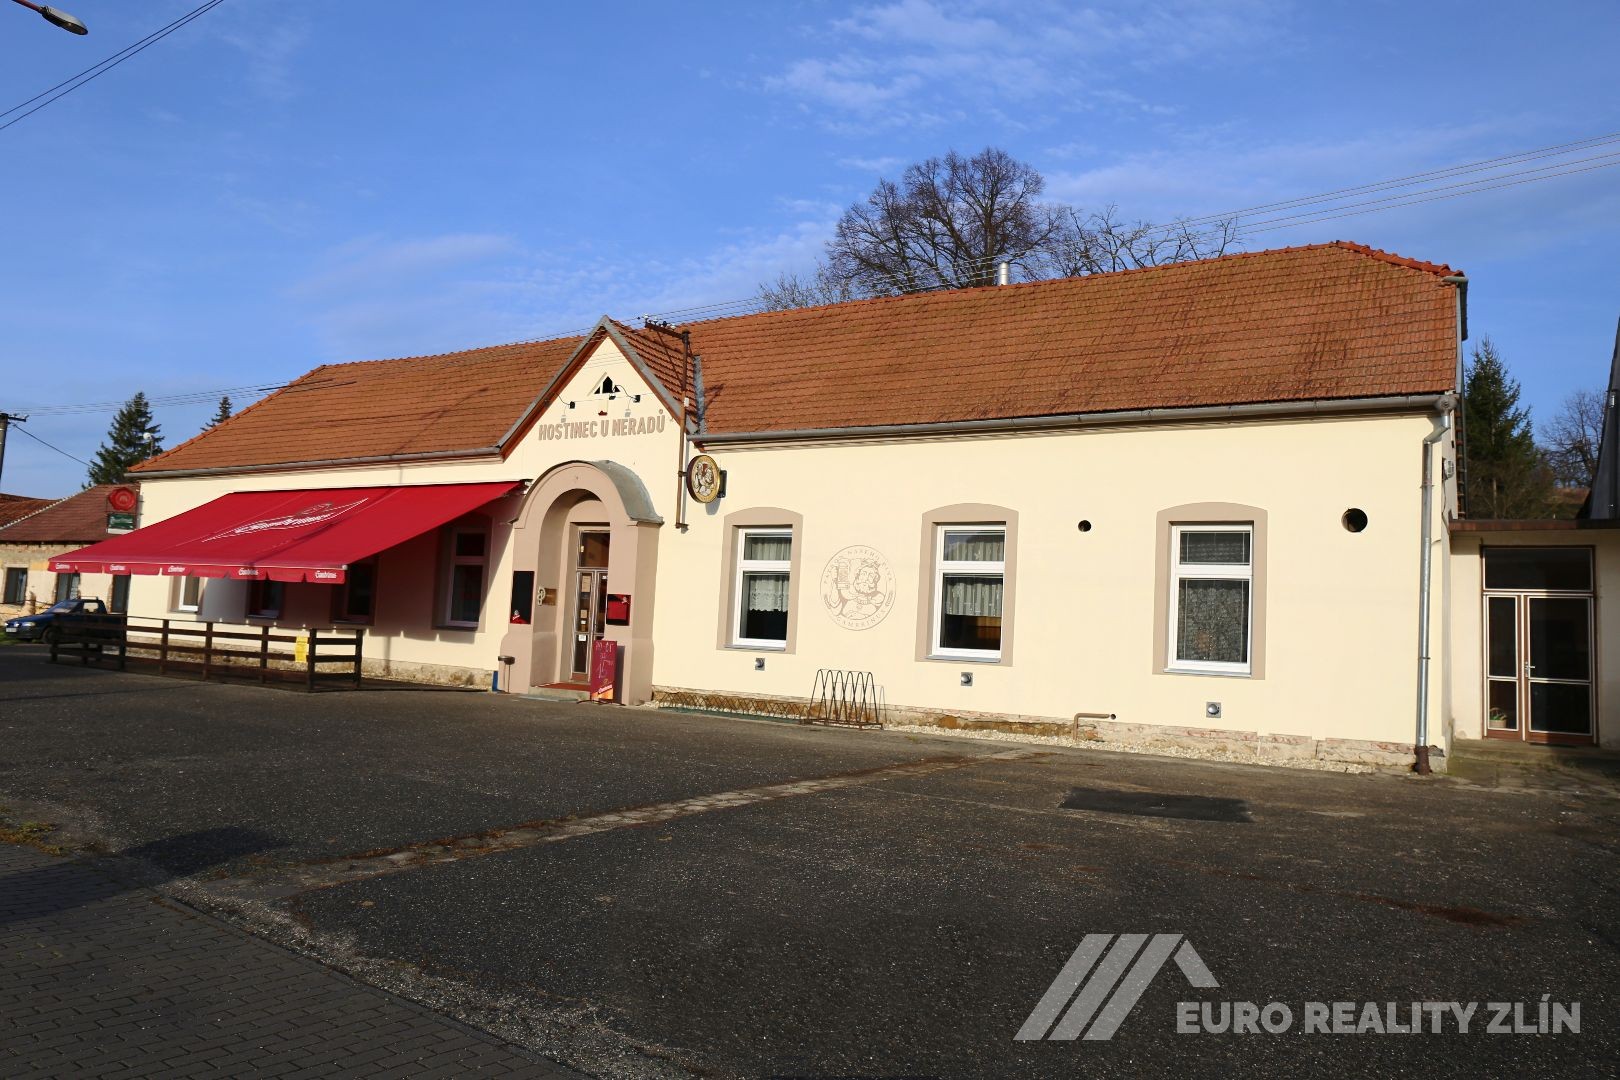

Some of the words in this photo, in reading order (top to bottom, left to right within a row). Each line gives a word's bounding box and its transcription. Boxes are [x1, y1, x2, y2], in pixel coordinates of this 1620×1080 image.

[538, 421, 598, 441] HOSTINEC
[600, 419, 609, 437] U
[612, 408, 666, 436] NERADŮ
